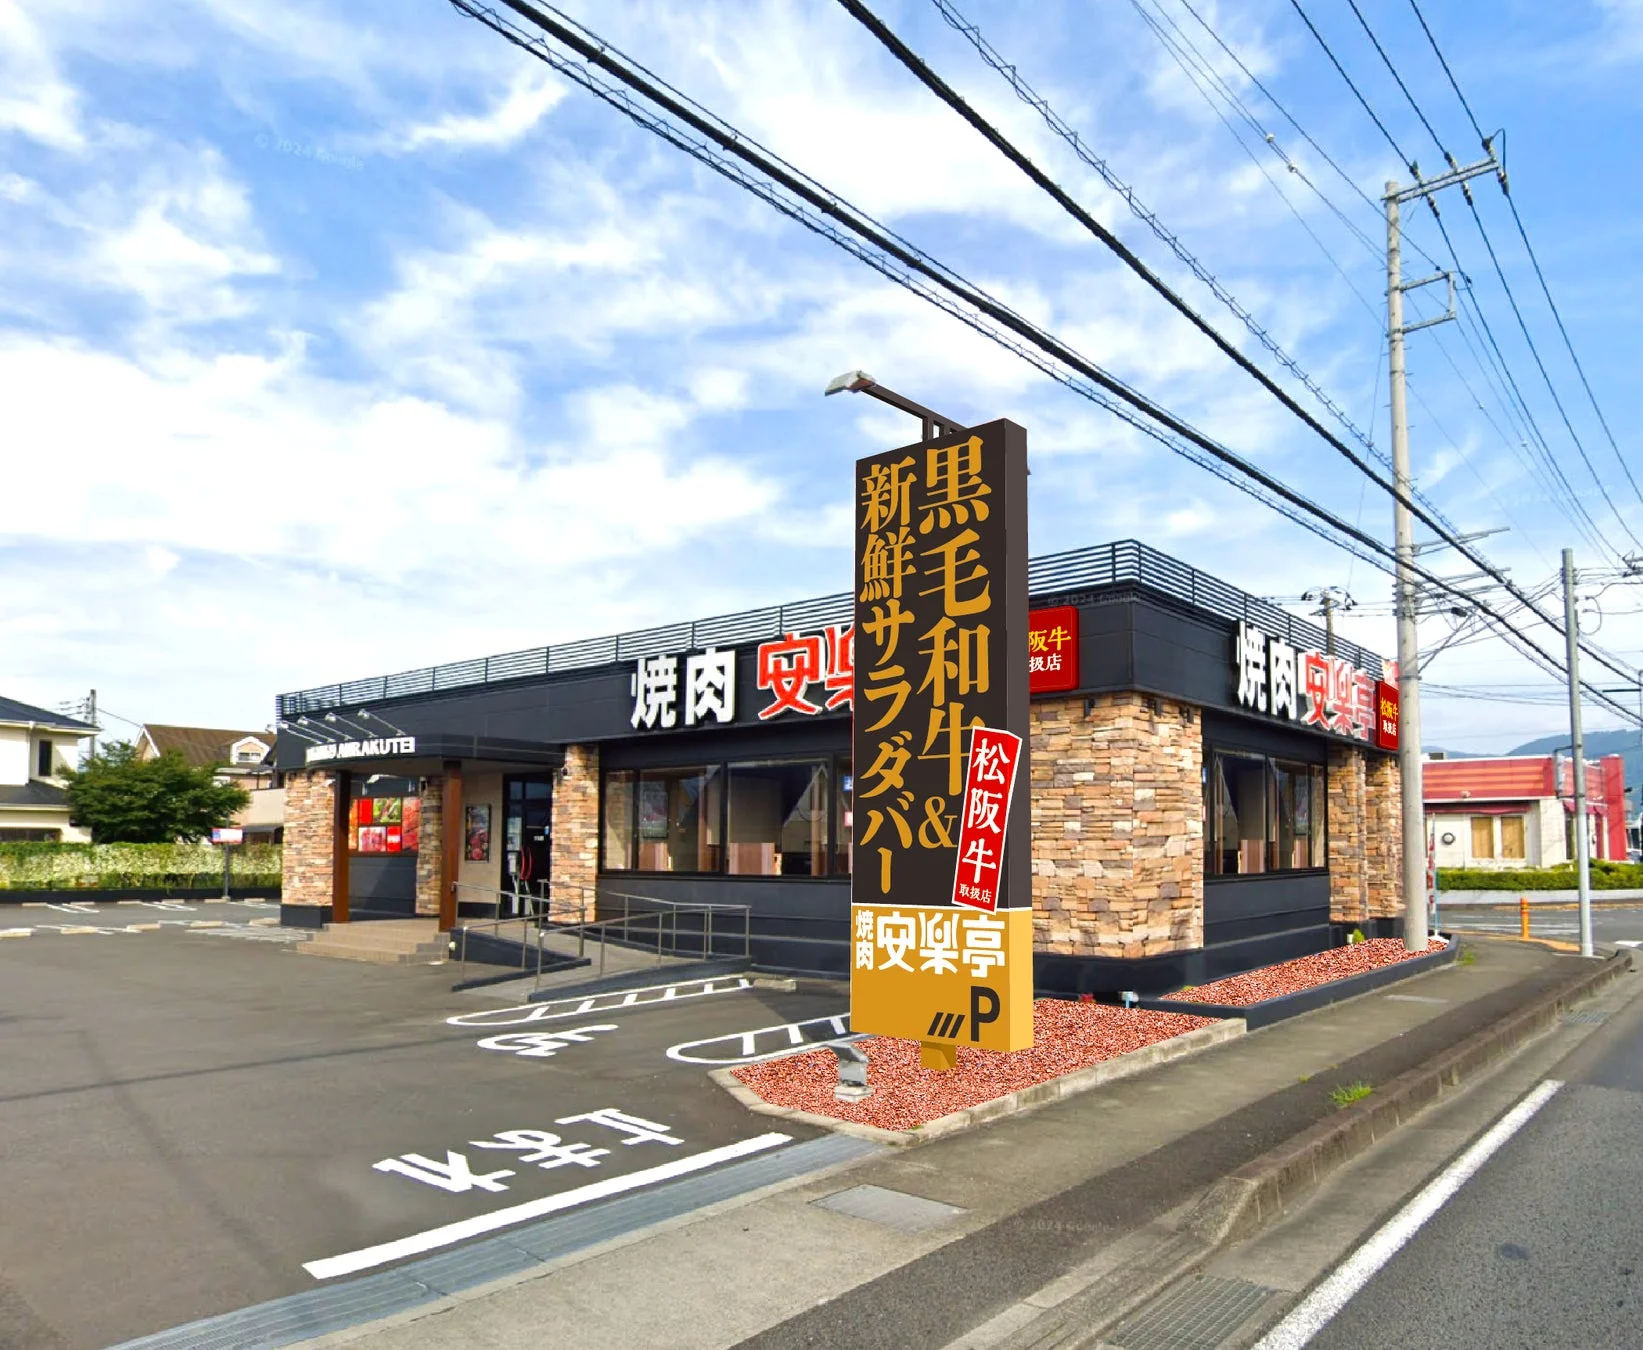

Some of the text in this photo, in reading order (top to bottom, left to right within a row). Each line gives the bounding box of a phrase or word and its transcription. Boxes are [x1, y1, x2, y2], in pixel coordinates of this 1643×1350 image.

[631, 647, 735, 729] 焼肉
[859, 456, 917, 894] 新鮮サラダバー
[1236, 620, 1376, 741] 焼肉 安楽亭
[962, 737, 1010, 885] 松阪牛
[958, 883, 992, 905] 取扱店
[855, 909, 874, 971] 焼肉
[877, 911, 1006, 978] 安楽亭
[970, 986, 1001, 1042] P
[371, 1108, 685, 1193] 止まれ
